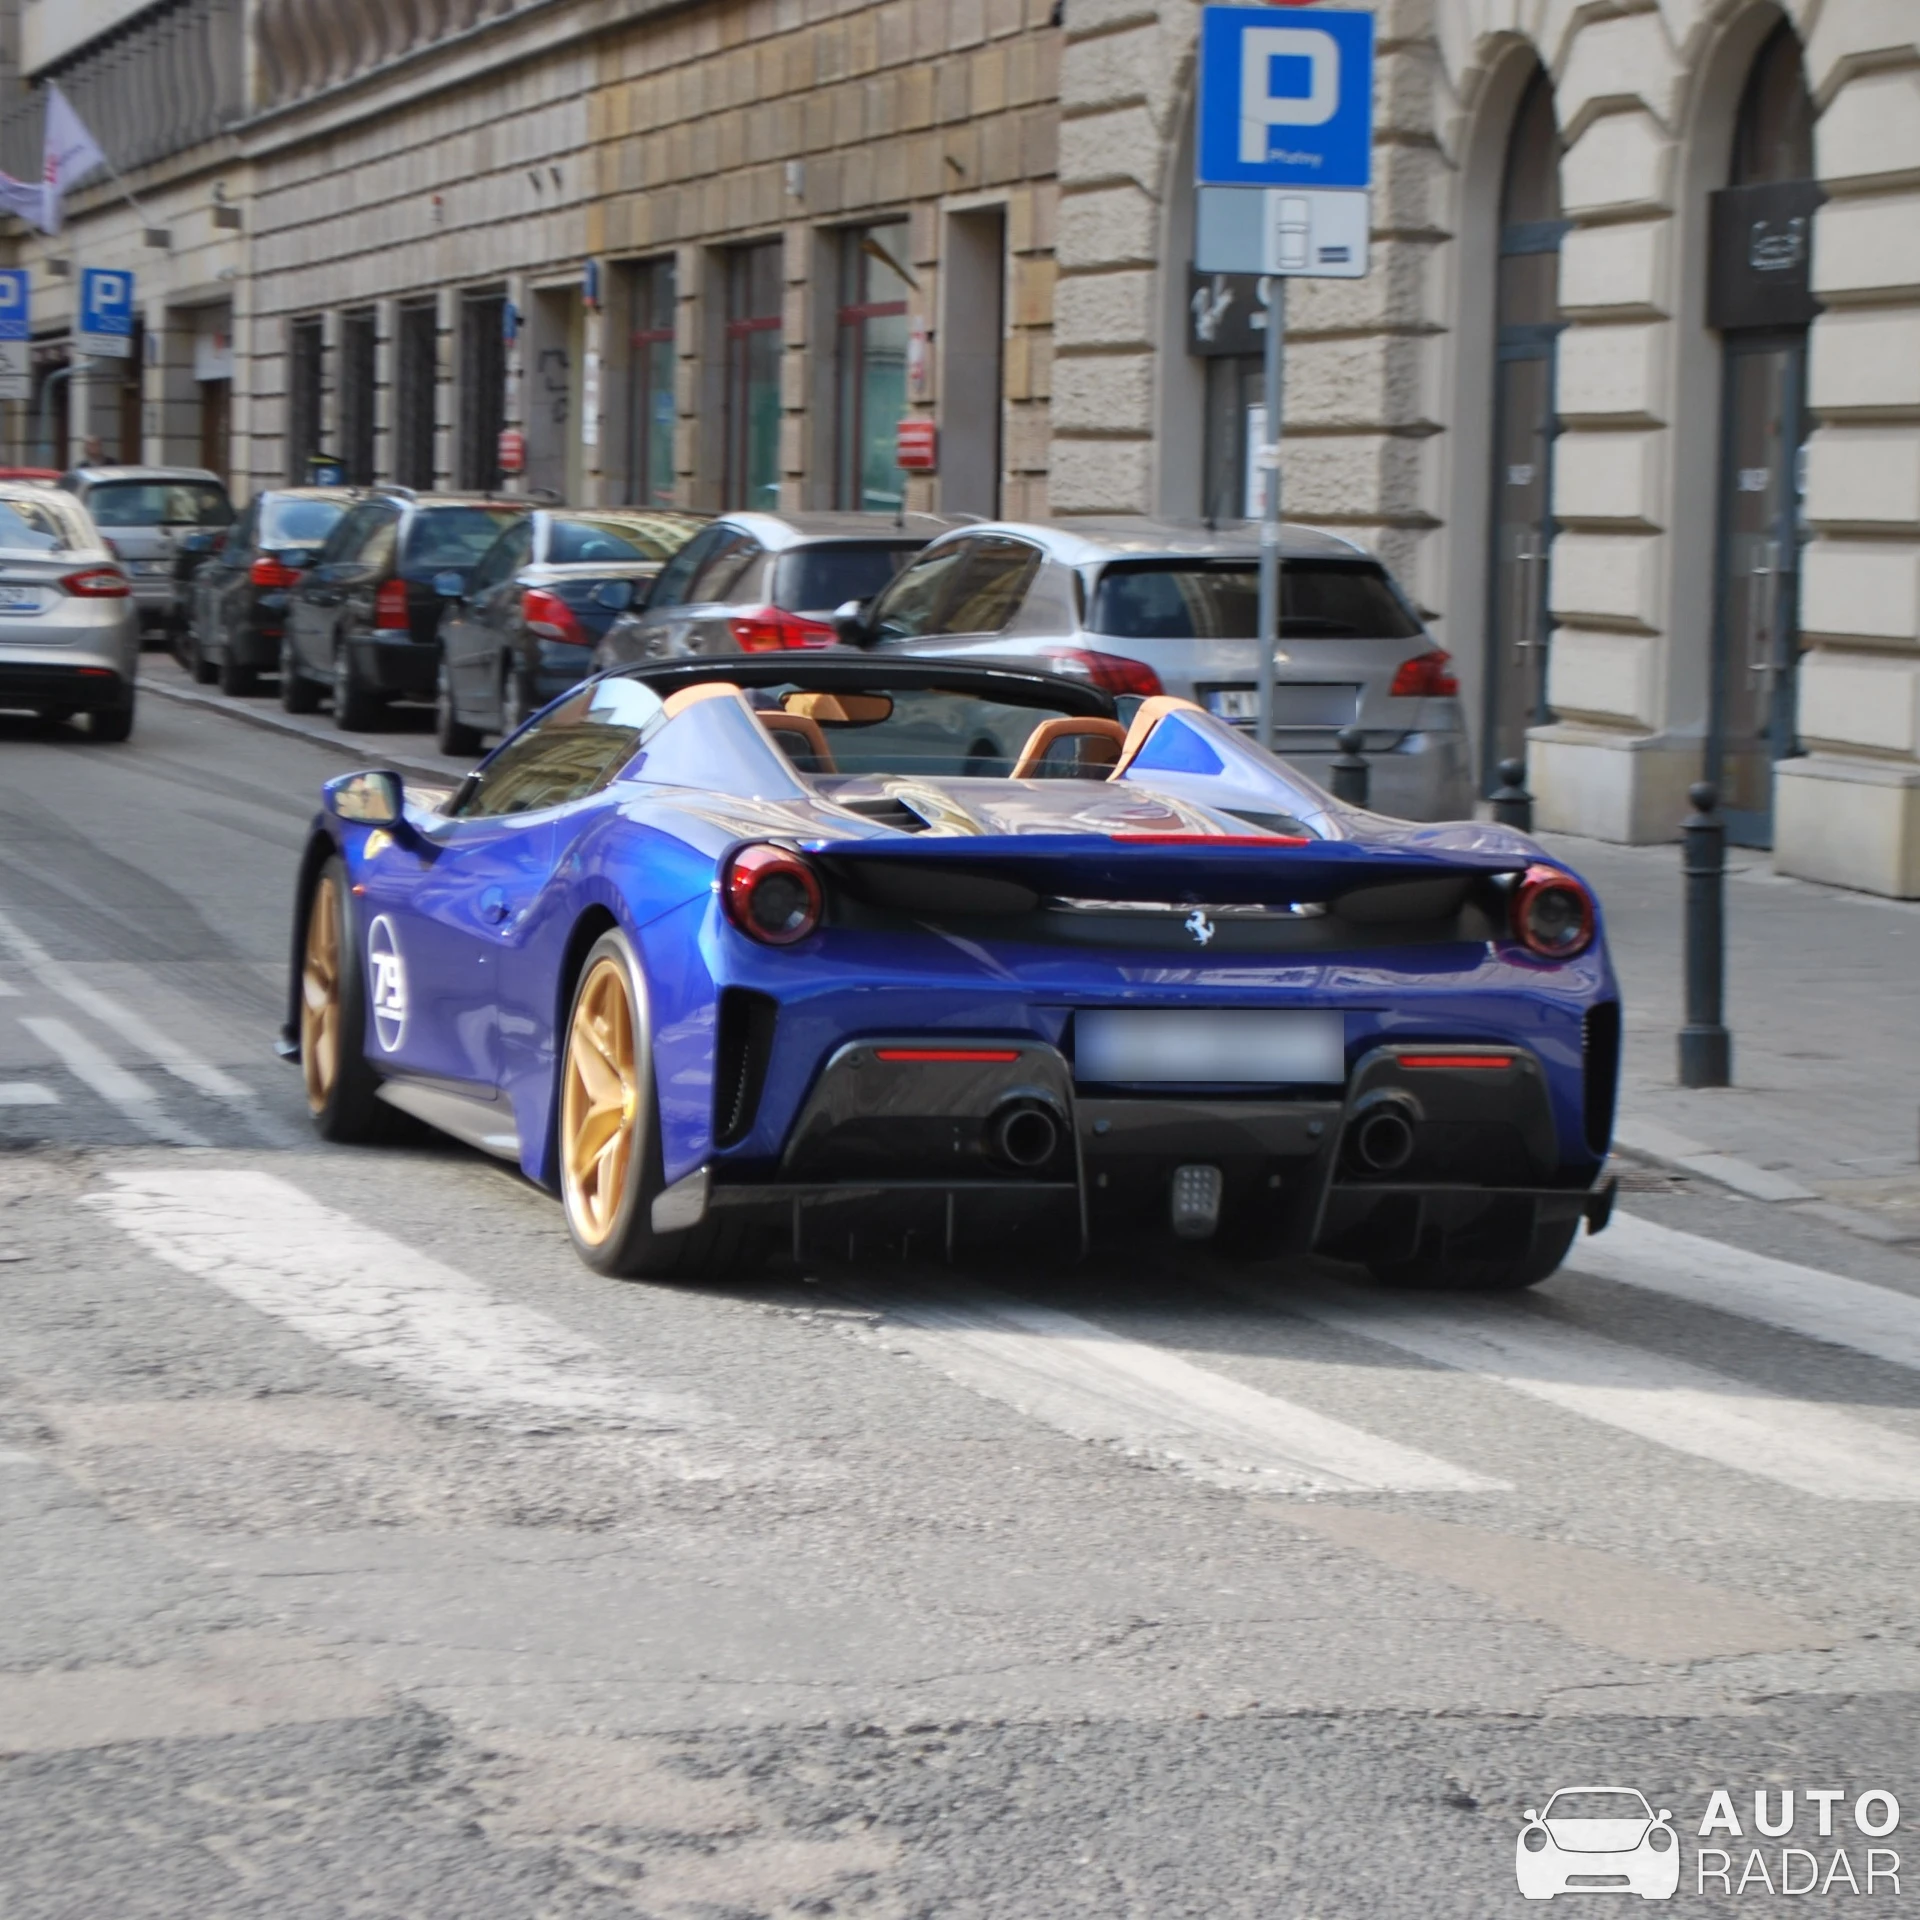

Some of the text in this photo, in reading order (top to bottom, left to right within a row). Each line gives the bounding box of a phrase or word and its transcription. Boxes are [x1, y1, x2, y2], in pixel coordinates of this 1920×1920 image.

[1238, 27, 1340, 164] P
[91, 274, 125, 313] P
[371, 952, 406, 1009] 79
